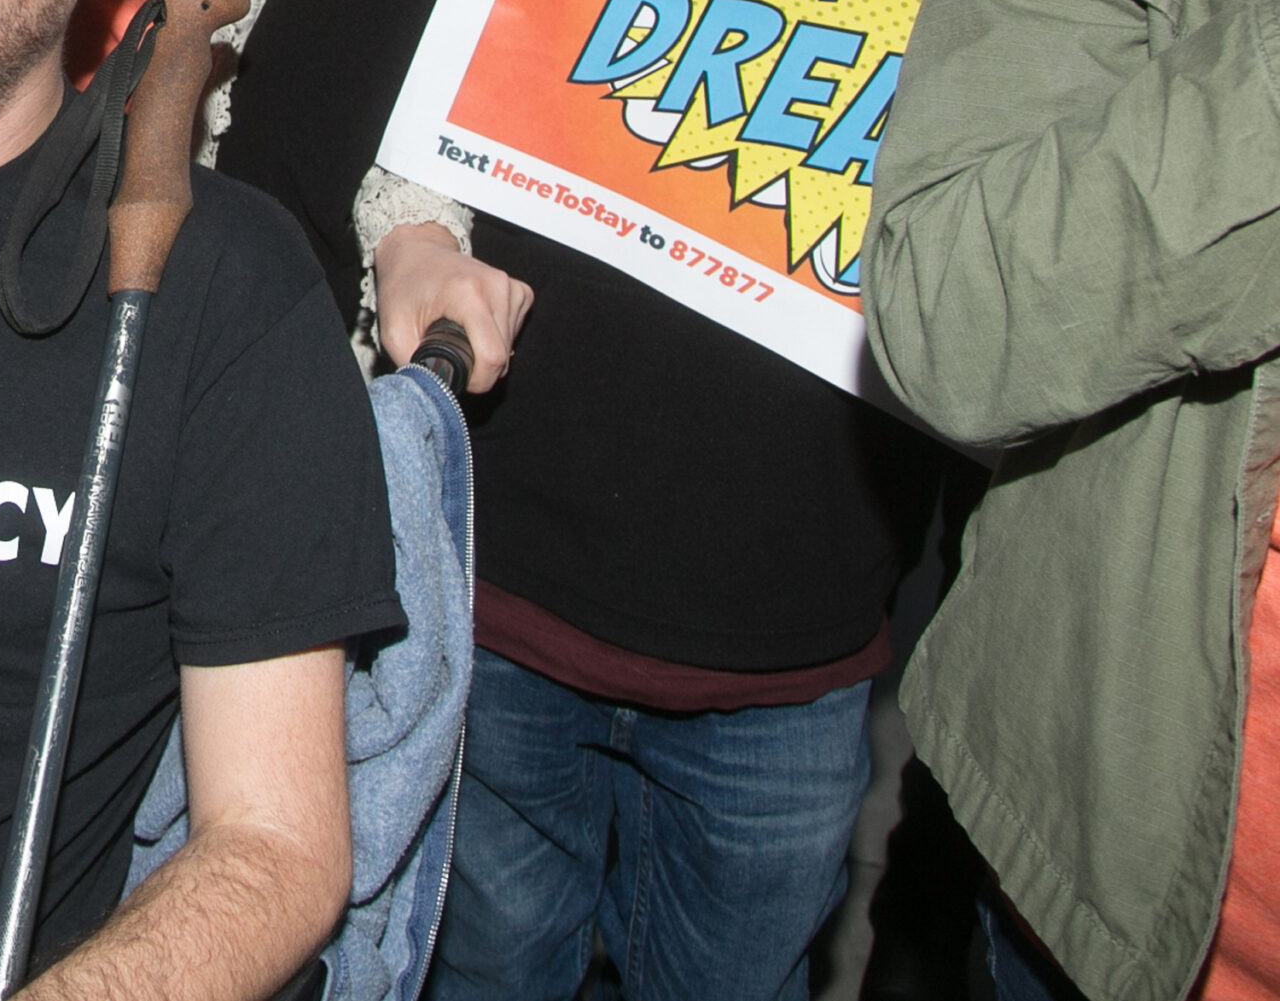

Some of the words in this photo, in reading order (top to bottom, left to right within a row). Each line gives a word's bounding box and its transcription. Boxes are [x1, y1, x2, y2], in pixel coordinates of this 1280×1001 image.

[437, 135, 490, 174] Text
[491, 159, 636, 237] HereToStay
[639, 224, 666, 250] to
[669, 240, 775, 303] 877877
